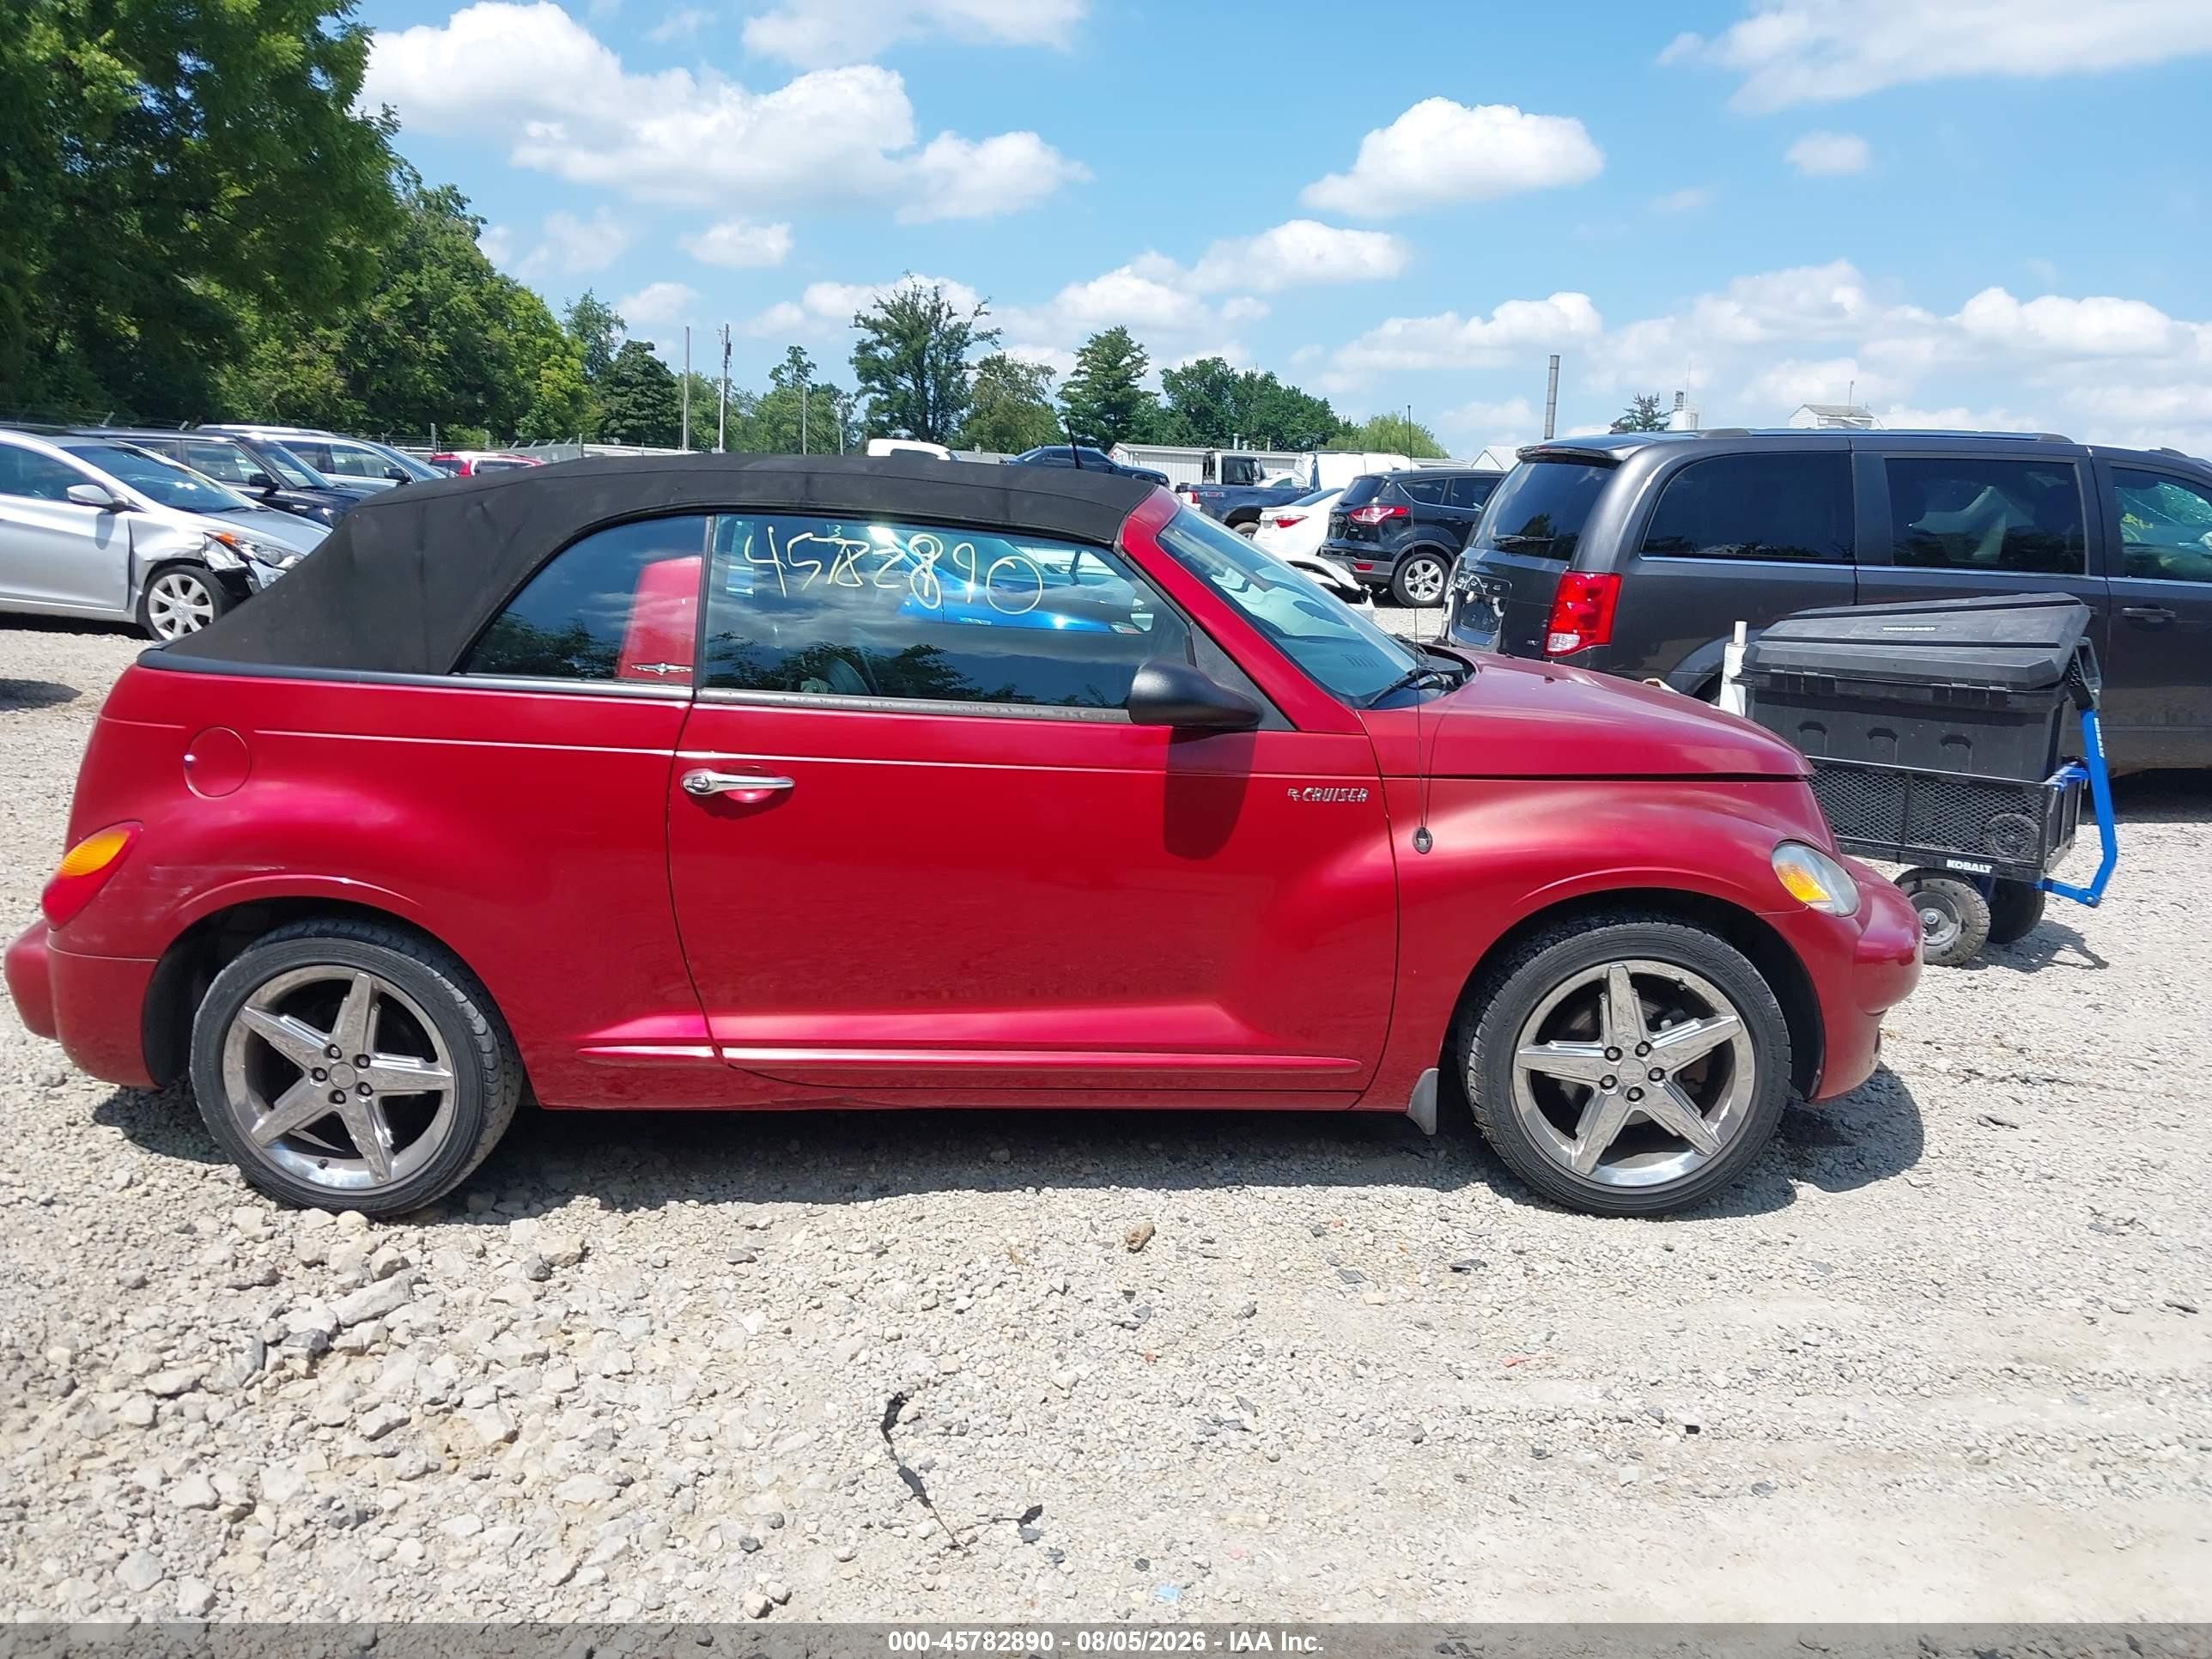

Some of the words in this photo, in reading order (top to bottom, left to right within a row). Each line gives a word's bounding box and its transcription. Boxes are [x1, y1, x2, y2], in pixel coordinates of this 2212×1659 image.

[744, 526, 1043, 616] 45782890
[1302, 787, 1370, 802] CRUISER
[1946, 859, 1993, 874] KOBALT
